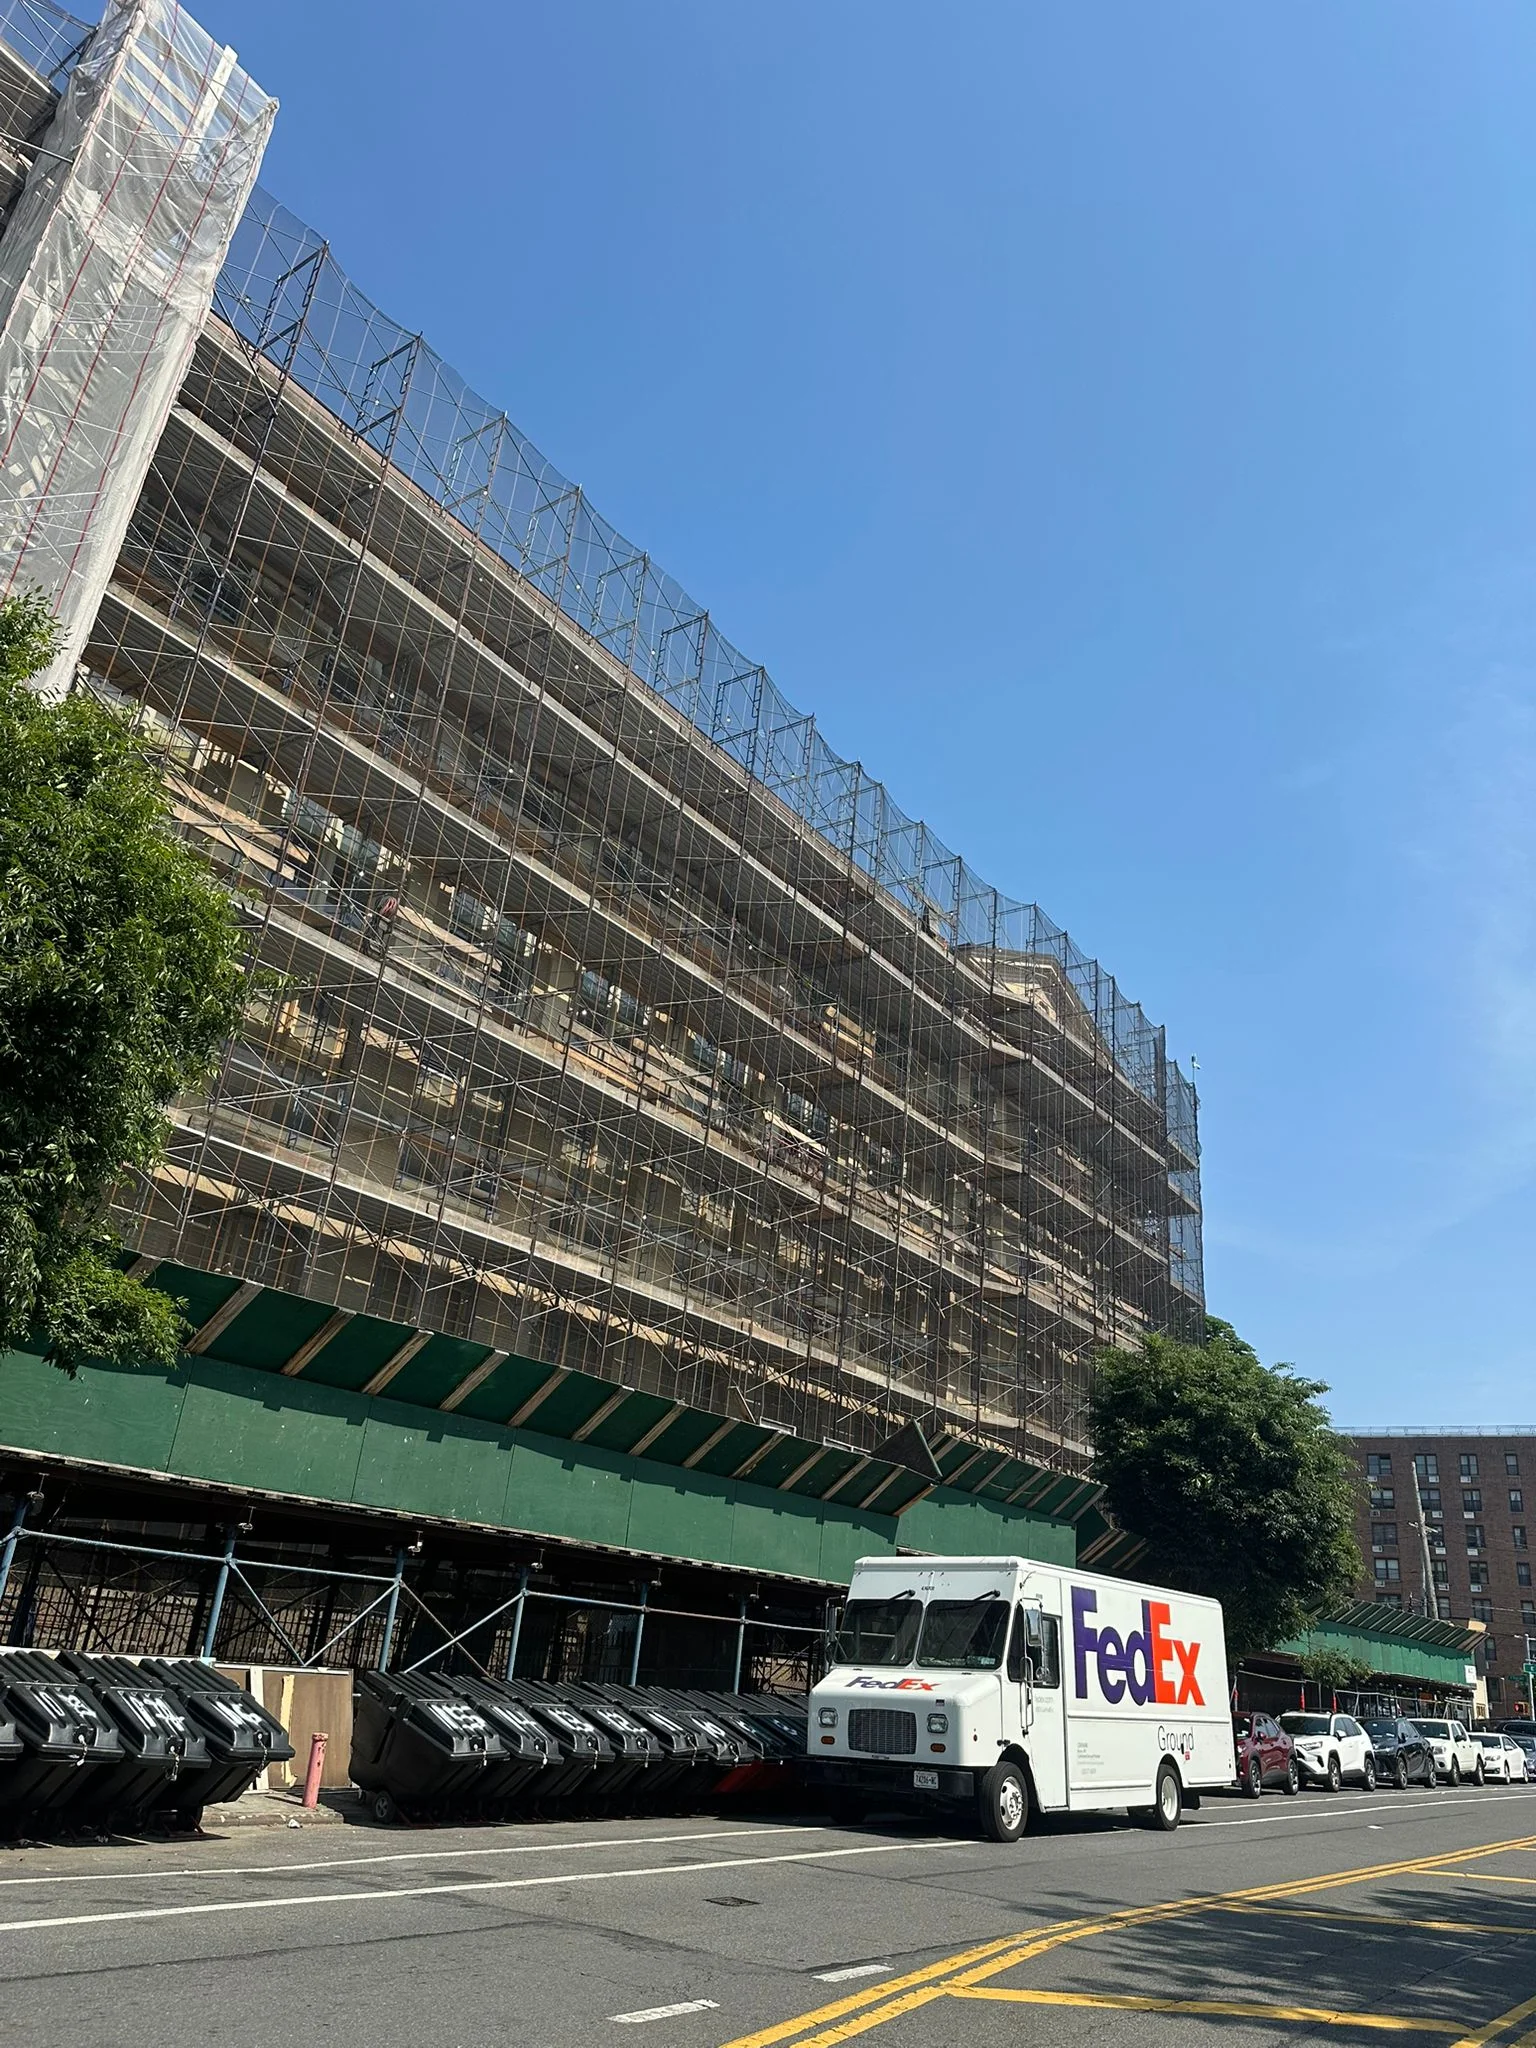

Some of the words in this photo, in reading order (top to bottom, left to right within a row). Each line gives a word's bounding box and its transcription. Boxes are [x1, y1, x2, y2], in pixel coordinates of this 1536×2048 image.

[1071, 1585, 1206, 1706] FedEx
[844, 1676, 942, 1691] FedEx
[547, 1709, 595, 1732] 13
[597, 1709, 648, 1733] 12
[1158, 1725, 1194, 1751] Ground
